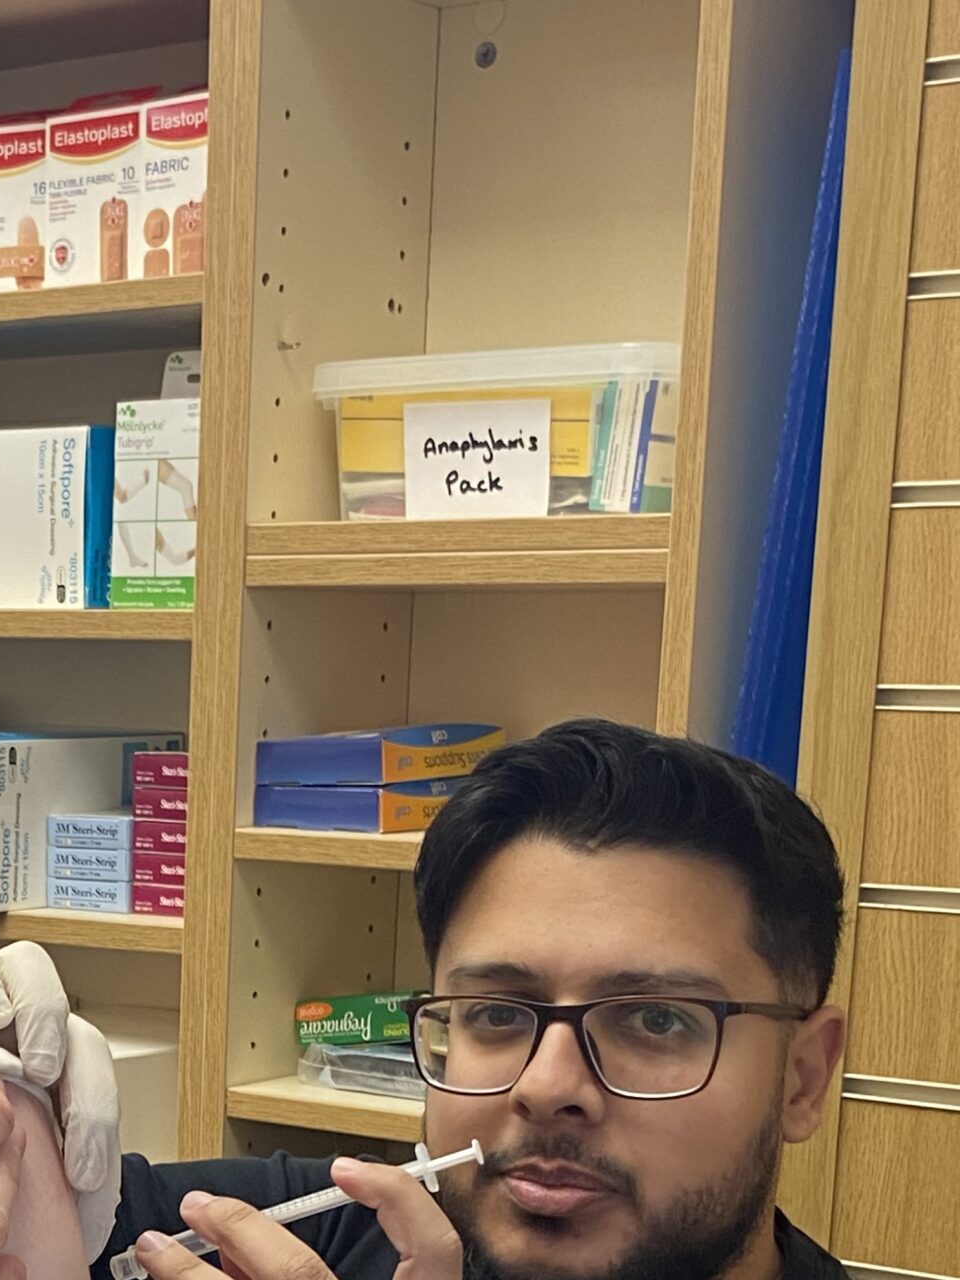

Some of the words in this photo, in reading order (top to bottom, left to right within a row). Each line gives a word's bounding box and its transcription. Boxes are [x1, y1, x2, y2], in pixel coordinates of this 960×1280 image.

[151, 107, 208, 132] Elastopl
[54, 122, 134, 148] Elastoplast
[122, 166, 135, 181] 10
[145, 157, 189, 177] FABRIC
[33, 182, 46, 195] 16
[446, 470, 503, 496] Pack
[55, 822, 70, 834] 3M
[72, 823, 118, 838] Steri-Strip
[54, 853, 70, 865] 3M
[71, 854, 117, 869] Steri-Strip
[54, 885, 70, 896] 3M
[70, 885, 117, 900] Steri-Strip
[300, 1011, 372, 1041] Pregnacare
